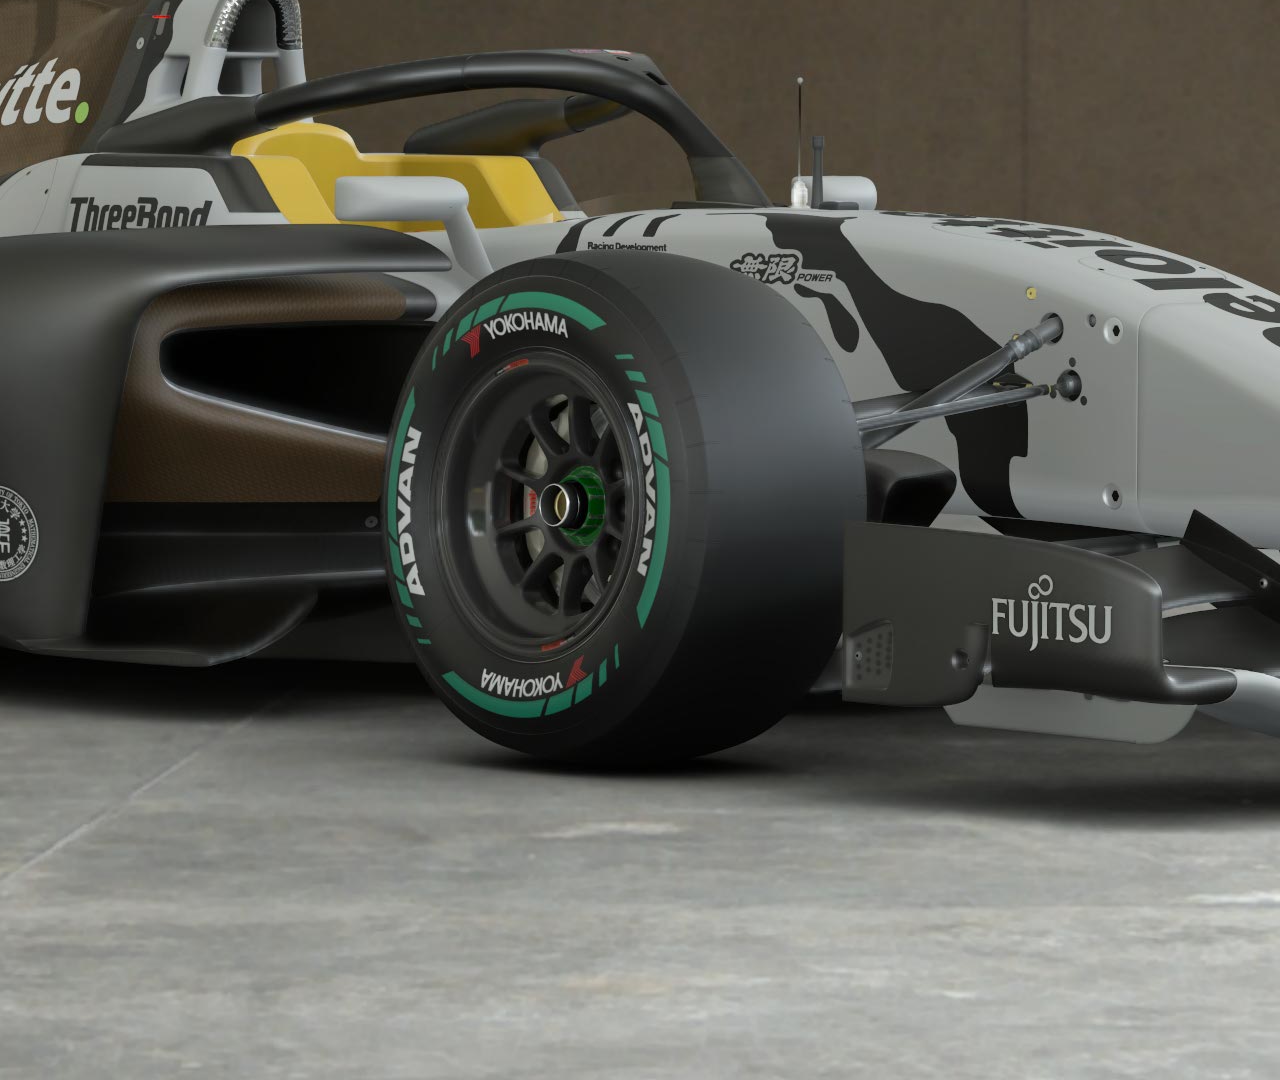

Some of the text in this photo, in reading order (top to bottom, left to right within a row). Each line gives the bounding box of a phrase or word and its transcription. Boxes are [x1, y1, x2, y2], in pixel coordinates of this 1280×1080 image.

[70, 196, 213, 233] ThreeBond
[587, 241, 667, 252] Racing Development
[797, 273, 833, 282] POWER
[483, 311, 569, 339] YOKOHAMA
[627, 402, 658, 578] ADVAN
[397, 425, 426, 596] ADVAN
[991, 594, 1113, 652] FUJITSU
[480, 667, 564, 698] YOKOHAMA
